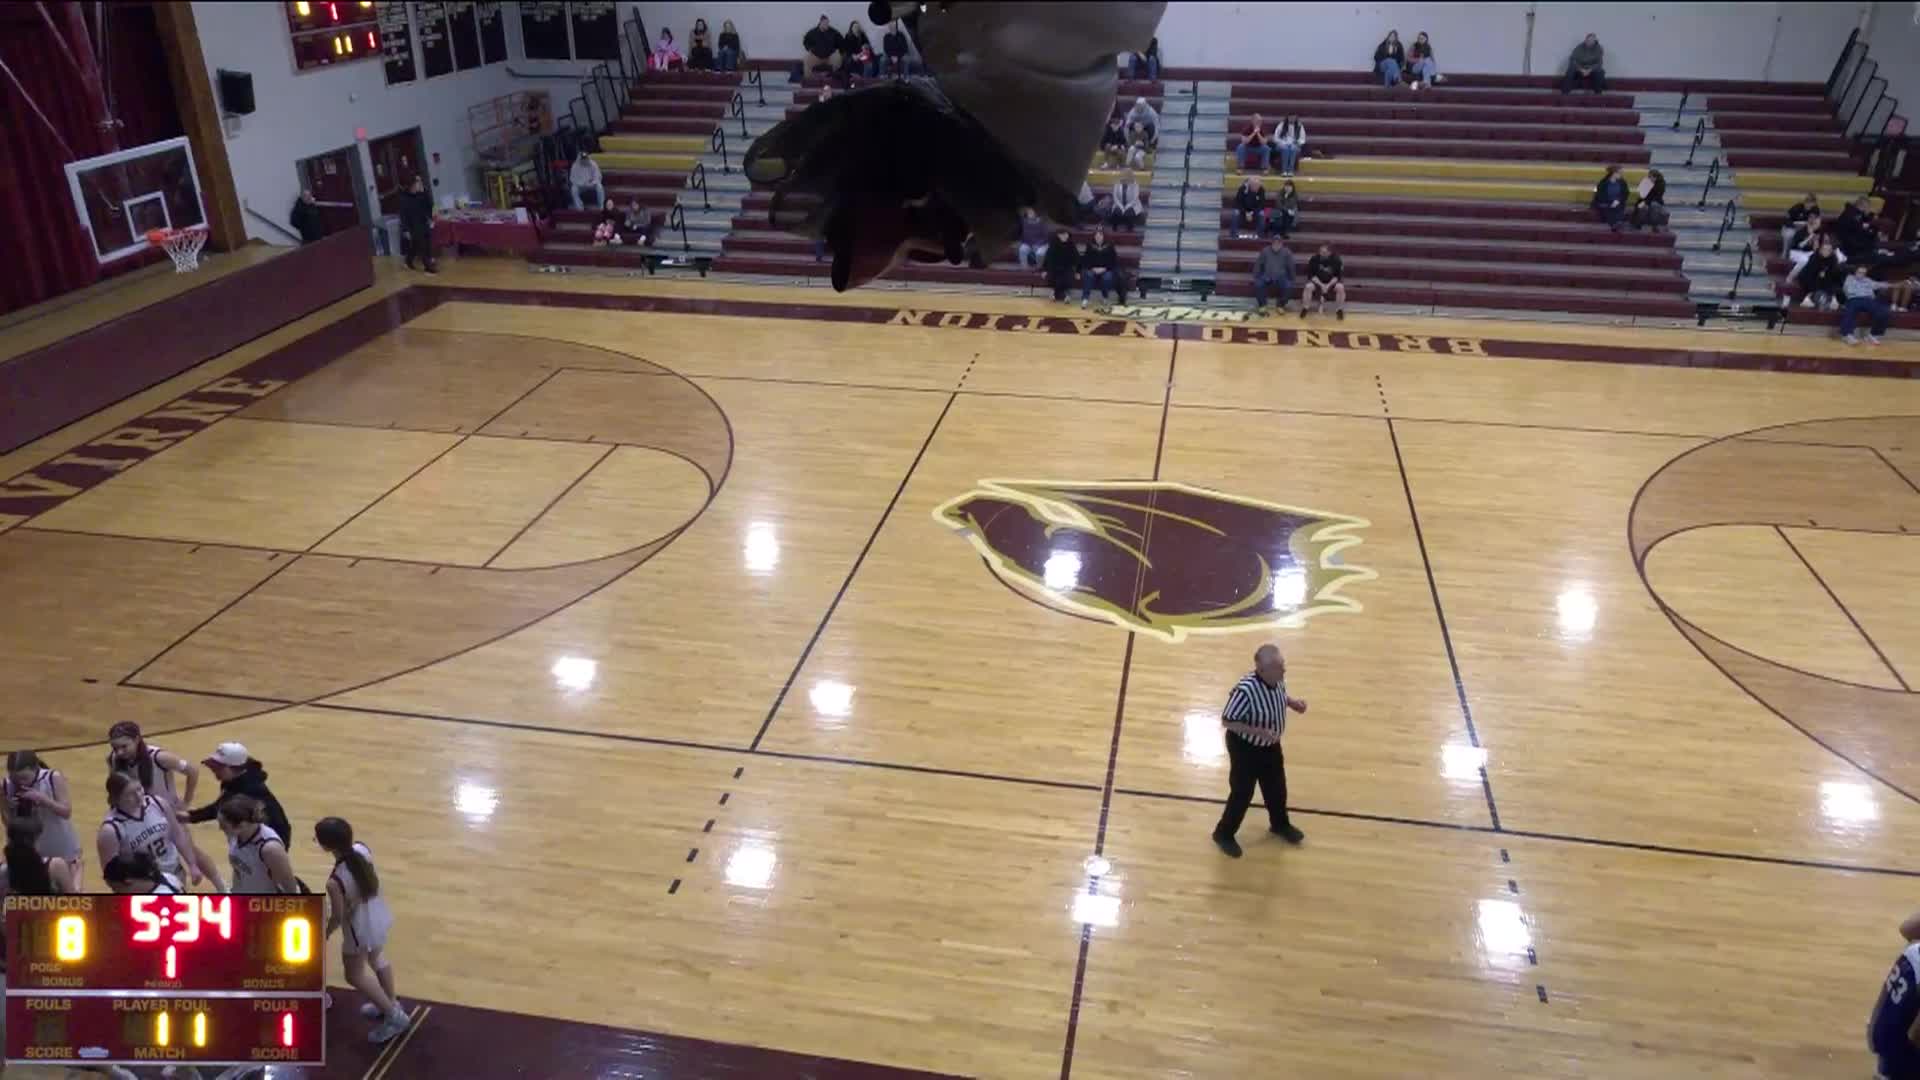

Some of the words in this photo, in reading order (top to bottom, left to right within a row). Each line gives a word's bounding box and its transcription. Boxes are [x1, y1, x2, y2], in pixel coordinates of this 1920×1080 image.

[888, 308, 1159, 338] NATION
[1202, 326, 1488, 356] BRONCO
[0, 378, 288, 531] VIRNE
